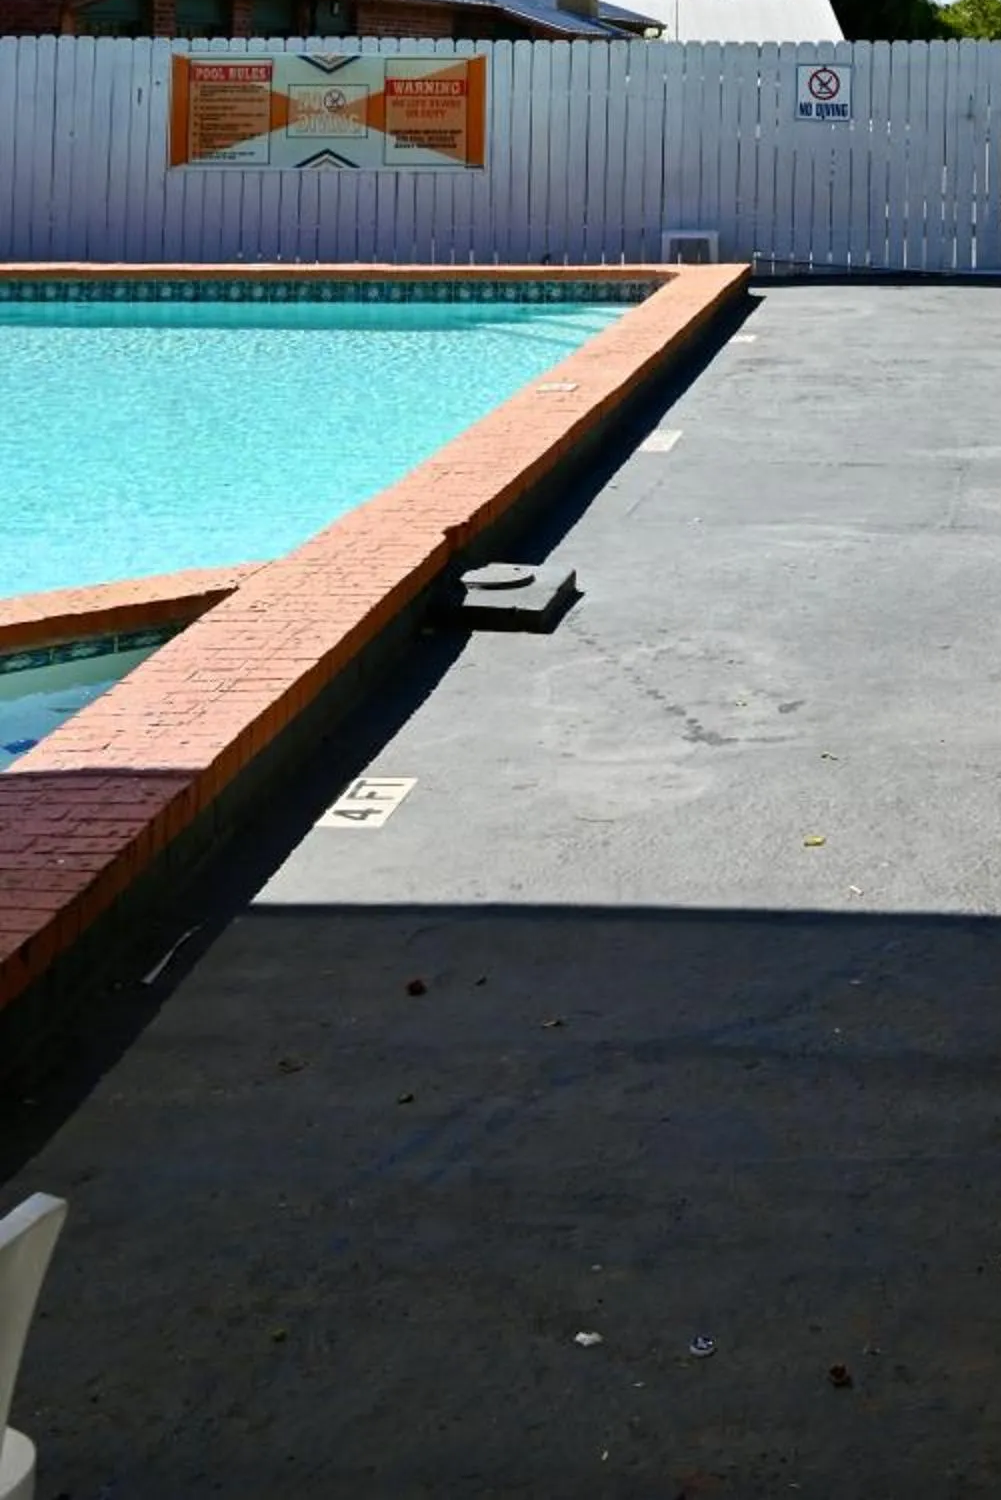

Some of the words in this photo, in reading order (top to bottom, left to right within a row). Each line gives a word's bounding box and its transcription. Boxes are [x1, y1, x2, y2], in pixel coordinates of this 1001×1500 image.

[195, 66, 226, 81] POOL
[229, 66, 267, 81] RULES
[393, 80, 462, 95] WARNING
[799, 102, 813, 117] NO
[815, 103, 849, 118] DIVING
[347, 779, 406, 801] FT
[332, 808, 385, 820] 4
